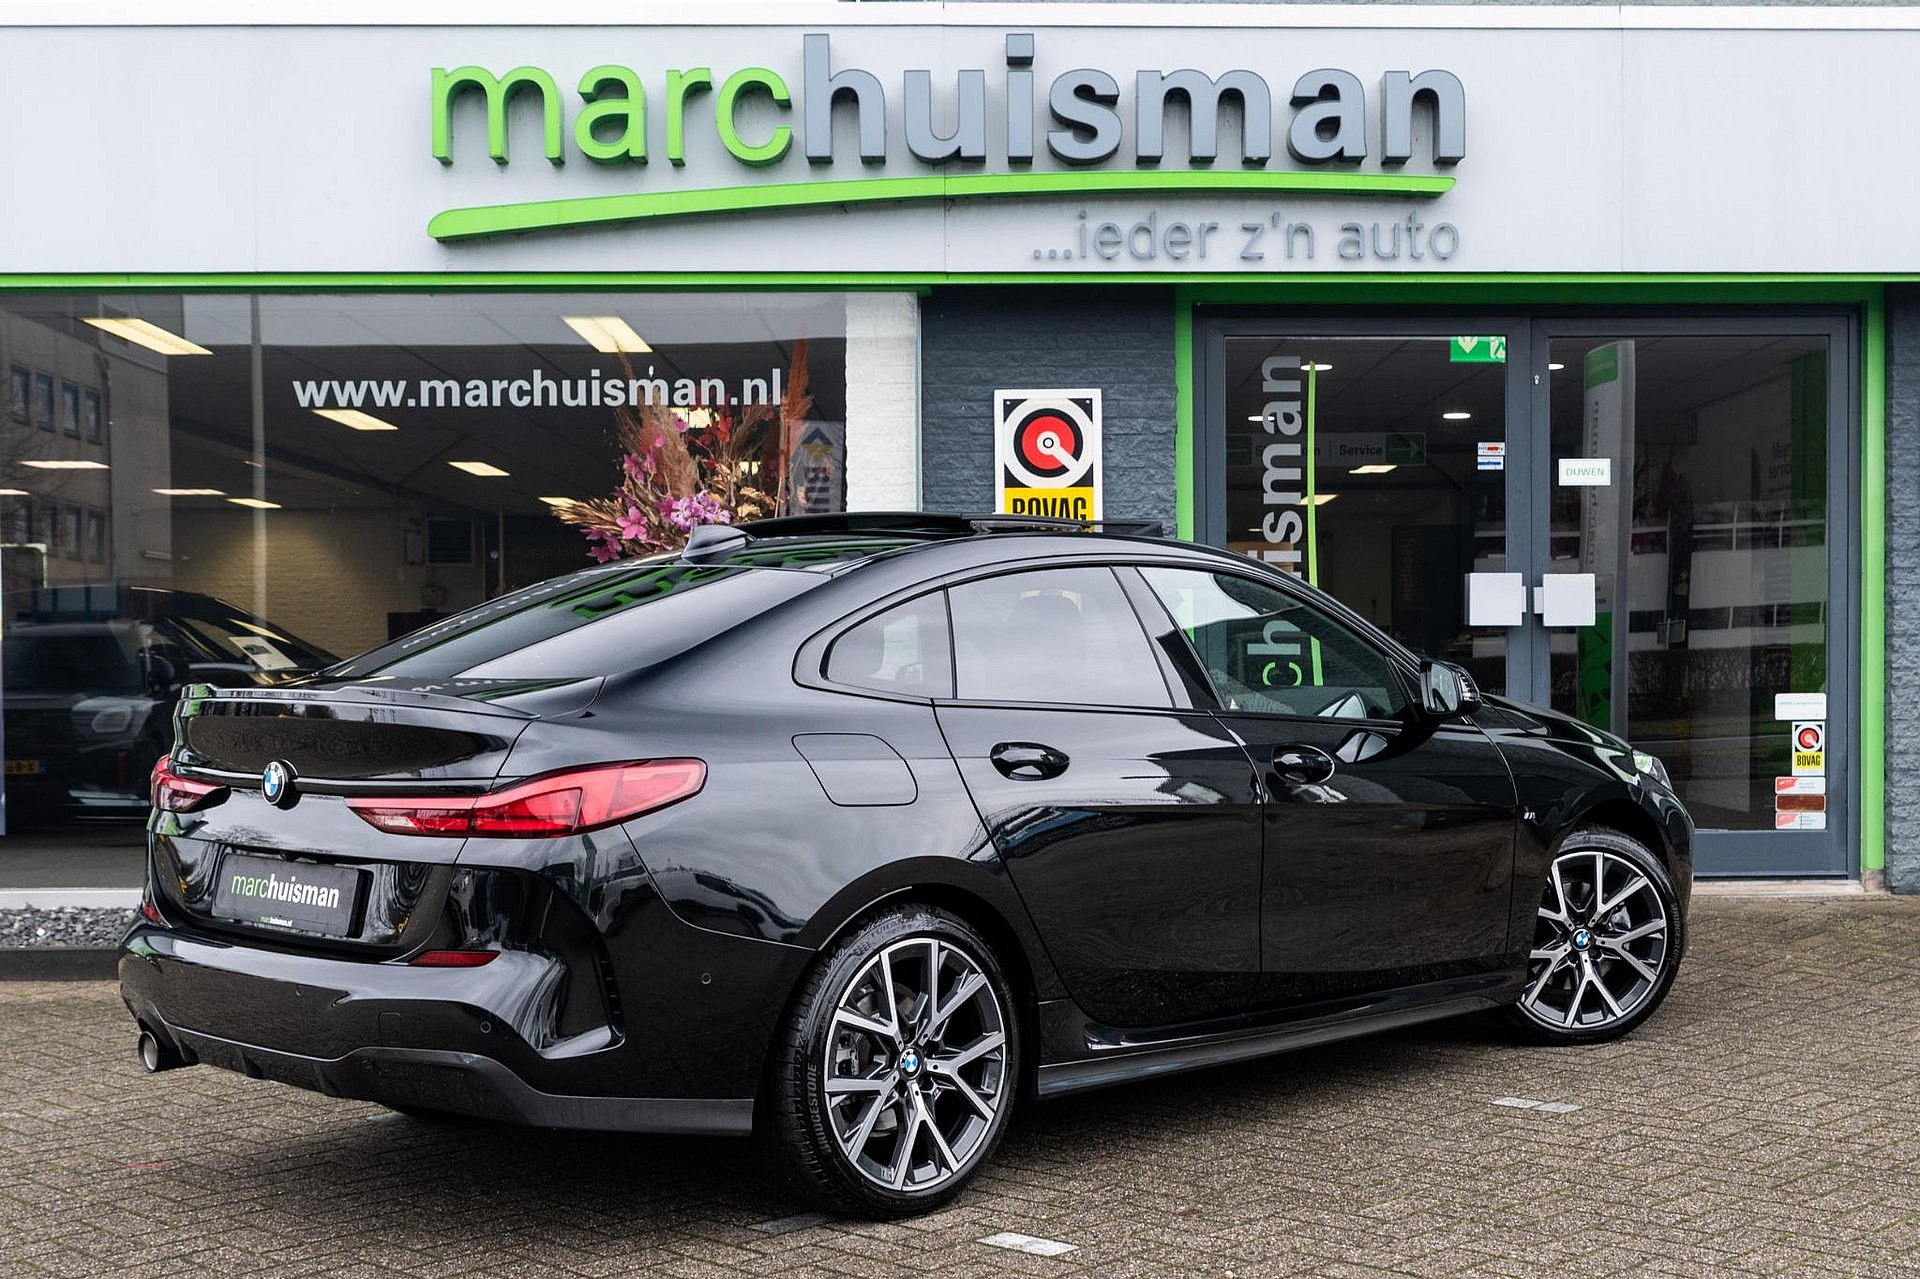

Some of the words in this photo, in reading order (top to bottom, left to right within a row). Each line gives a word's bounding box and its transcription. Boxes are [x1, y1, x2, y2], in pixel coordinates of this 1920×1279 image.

[430, 34, 1466, 166] marchuisman
[1240, 210, 1315, 261] z'n
[1337, 209, 1461, 261] auto
[292, 367, 782, 408] www.marchuisman.nl
[1339, 444, 1383, 456] Service
[1565, 467, 1605, 477] DUWEN
[1796, 754, 1821, 766] BOVAG
[231, 873, 340, 909] marchuisman
